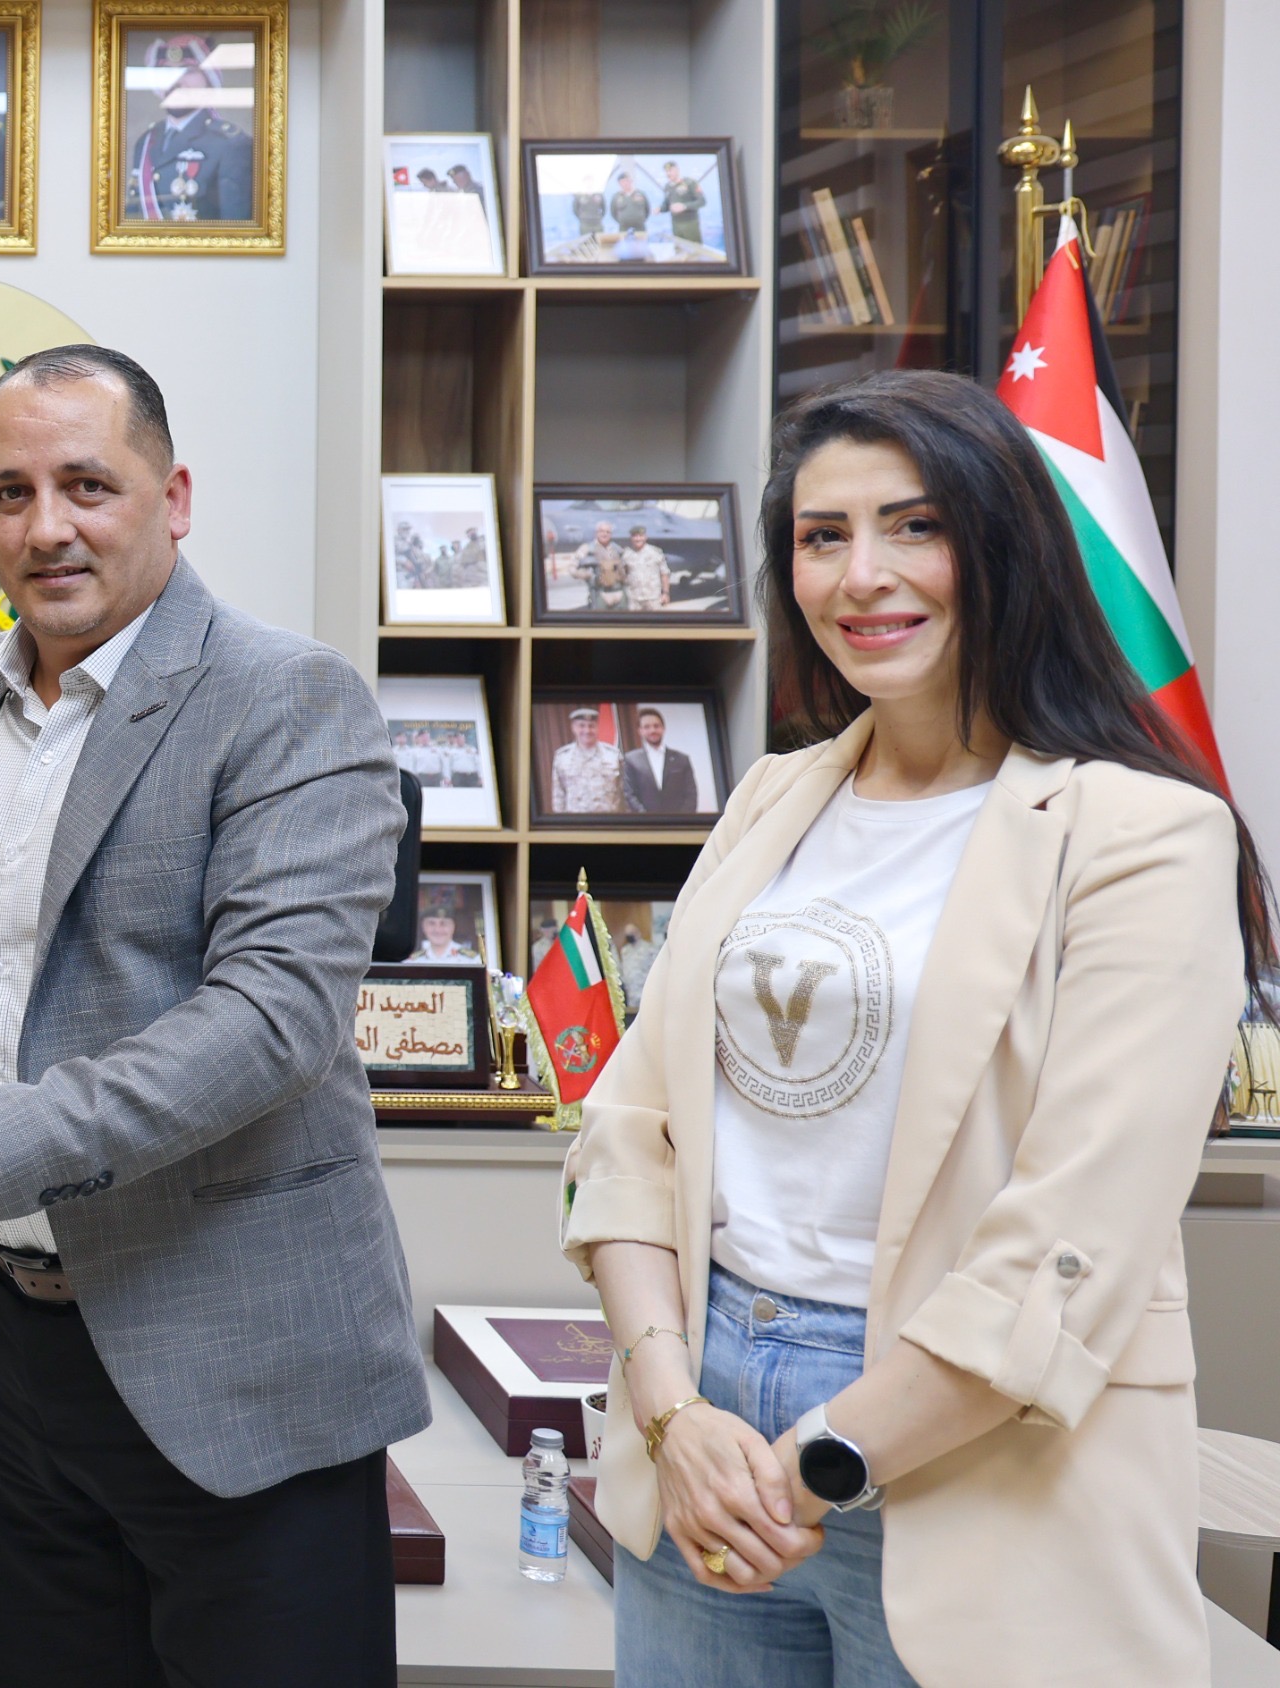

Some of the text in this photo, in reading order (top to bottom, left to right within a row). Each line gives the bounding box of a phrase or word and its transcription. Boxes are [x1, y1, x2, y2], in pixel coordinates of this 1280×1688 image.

[380, 991, 445, 1018] العميد
[744, 949, 840, 1068] V
[386, 1026, 464, 1060] مصطفى
